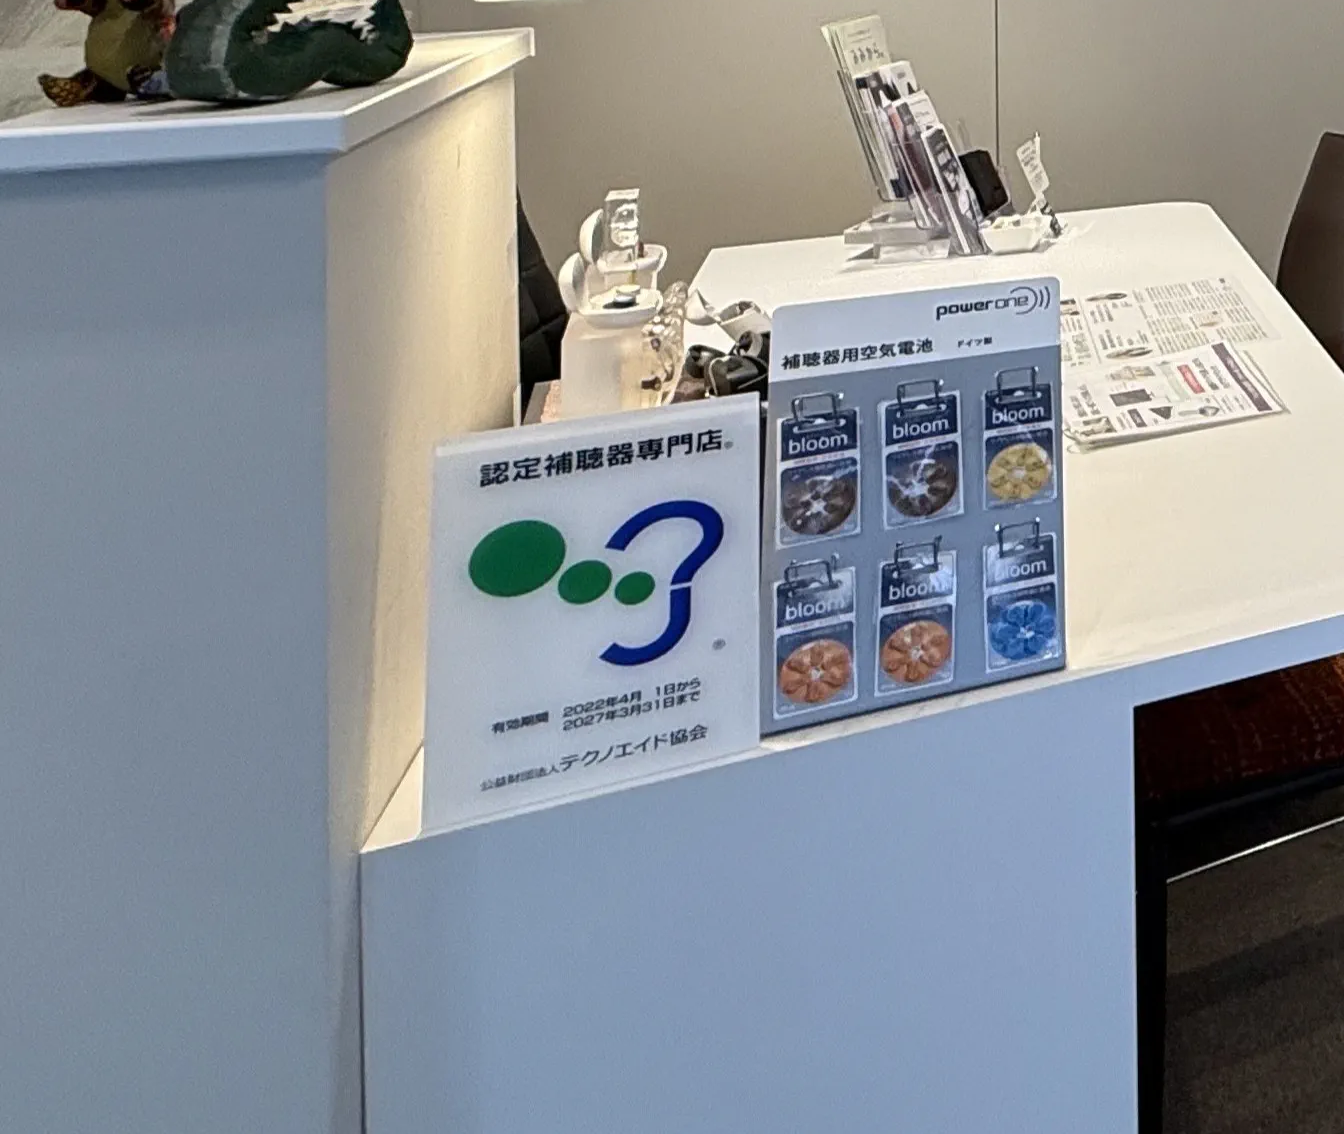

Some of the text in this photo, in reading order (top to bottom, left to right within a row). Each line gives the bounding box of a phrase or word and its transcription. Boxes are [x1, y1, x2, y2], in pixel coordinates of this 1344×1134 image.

[781, 338, 933, 370] 補聴器用空気電池
[992, 406, 1045, 424] bloom
[892, 418, 949, 440] bloom
[788, 434, 848, 455] bloom
[480, 430, 722, 487] 認定補聴器専門店
[785, 598, 845, 621] bloom
[563, 690, 642, 718] 2022年4月
[563, 692, 701, 731] 2027年3月31日まで
[492, 711, 549, 734] 有効期間
